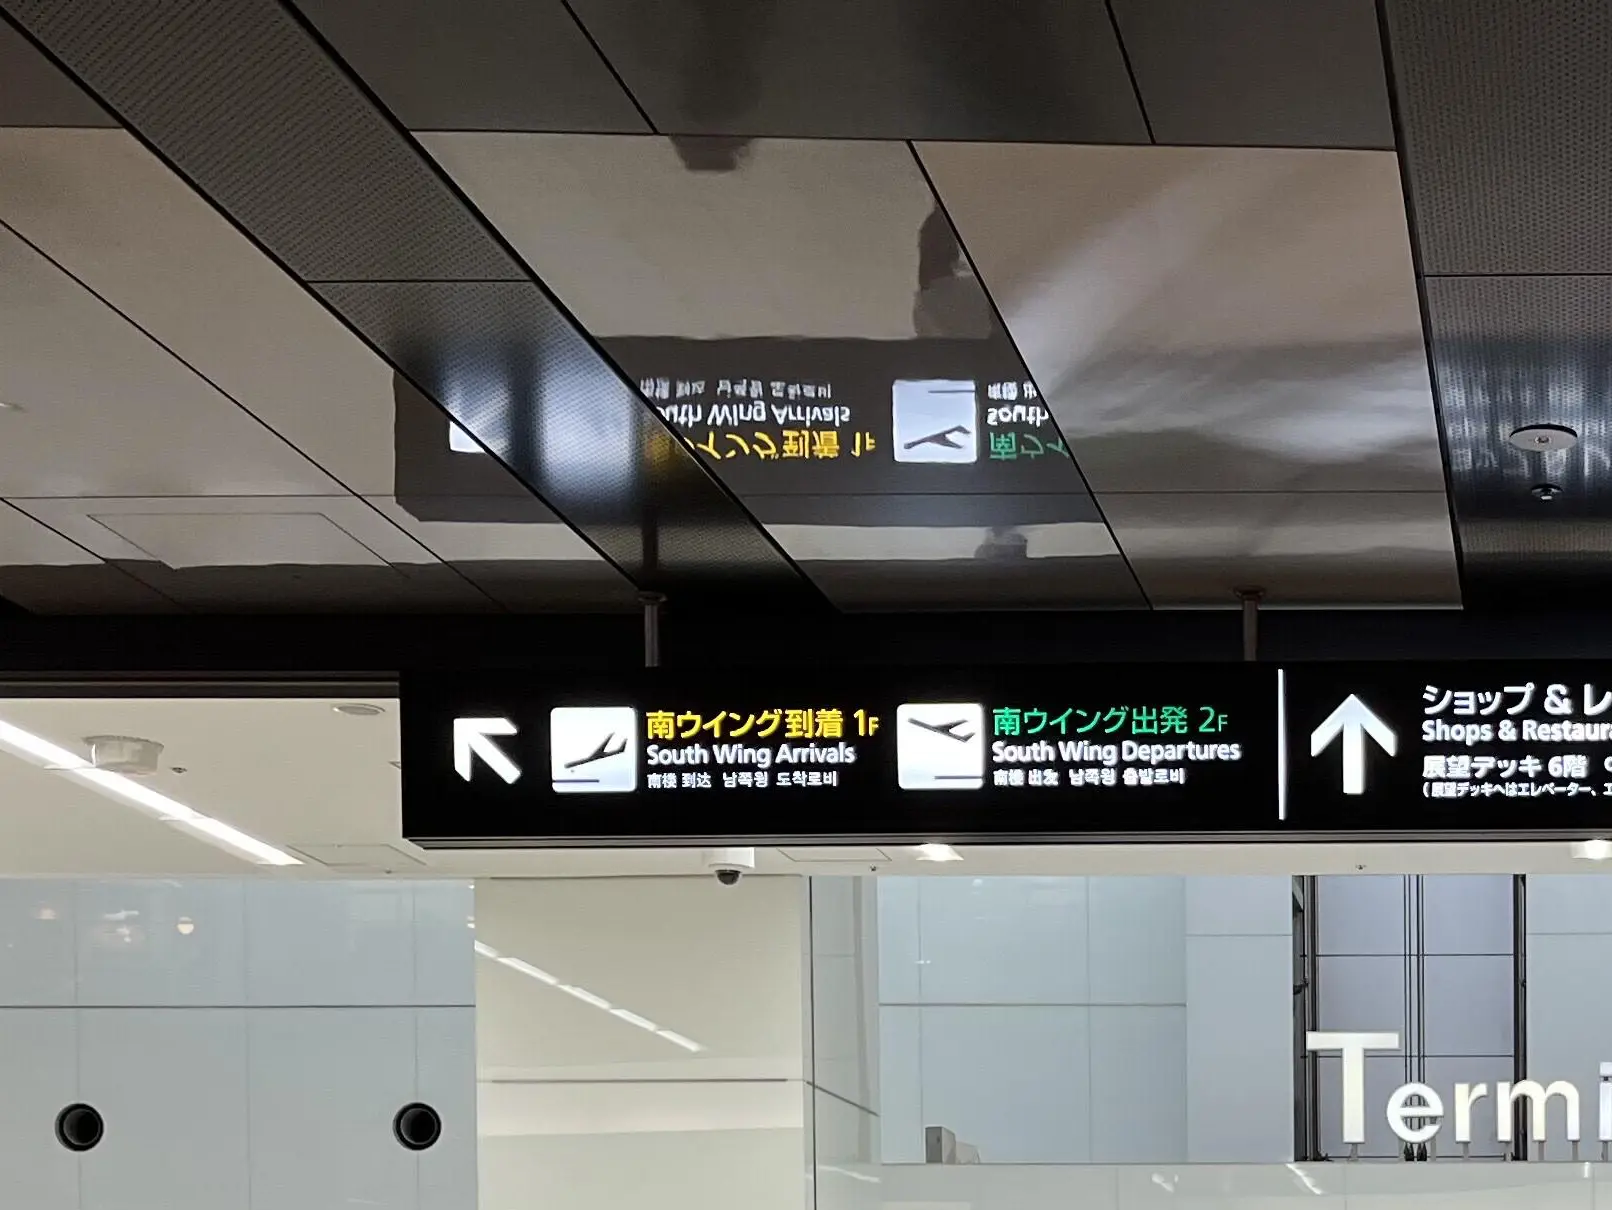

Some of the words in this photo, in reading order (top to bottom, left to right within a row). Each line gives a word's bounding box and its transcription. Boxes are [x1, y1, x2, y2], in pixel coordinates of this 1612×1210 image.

[1423, 682, 1535, 715] ショップ
[1544, 683, 1573, 715] &
[646, 708, 844, 740] 南ウイング到着
[853, 708, 880, 737] 1F
[992, 705, 1189, 736] 南ウイング出発
[1198, 706, 1228, 733] 2F
[1422, 719, 1494, 746] Shops
[1498, 720, 1518, 742] &
[646, 743, 709, 766] South
[712, 743, 772, 769] Wing
[775, 742, 856, 764] Arrivals
[991, 740, 1056, 763] South
[1058, 740, 1119, 766] Wing
[1121, 740, 1242, 765] Departures
[1422, 754, 1543, 779] 展望デッキ
[1548, 754, 1589, 779] 6階
[776, 770, 838, 788] 도착로비
